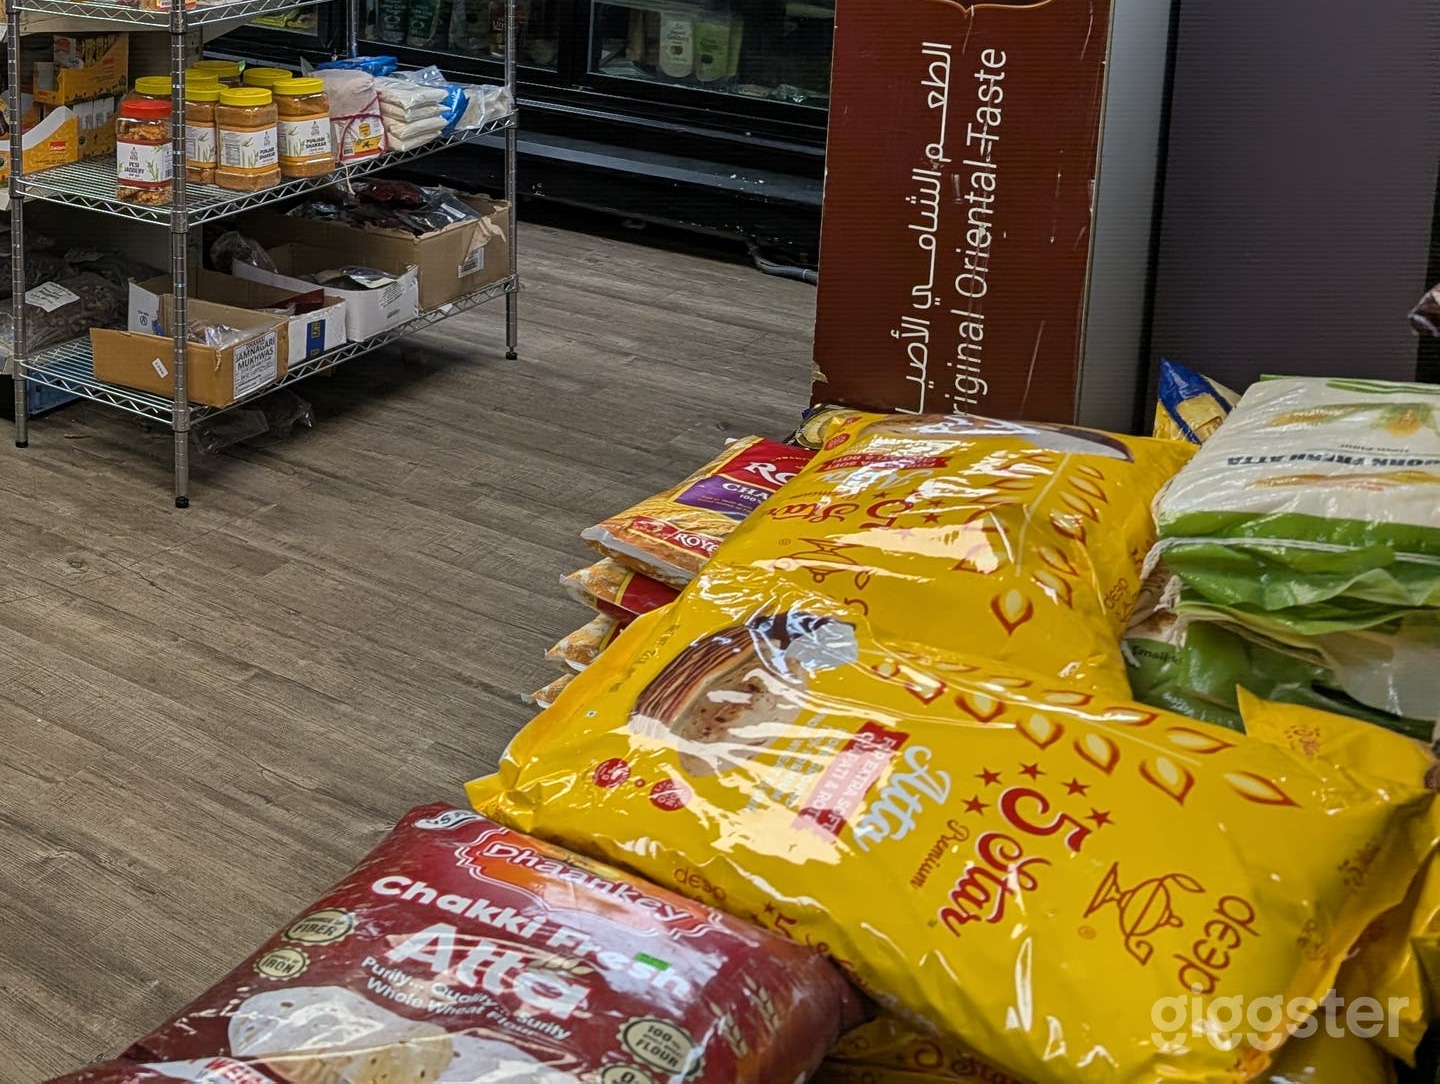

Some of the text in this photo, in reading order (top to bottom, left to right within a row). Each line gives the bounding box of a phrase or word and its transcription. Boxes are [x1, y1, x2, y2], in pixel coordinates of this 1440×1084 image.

[905, 169, 942, 310] الشامي
[944, 48, 1008, 415] riginal Oriental Taste
[237, 346, 274, 371] MUKHWAS
[722, 482, 769, 501] CHA
[859, 498, 916, 530] 5
[843, 762, 878, 799] EXTRA
[853, 745, 952, 853] Atta
[827, 795, 855, 835] SOFT
[998, 785, 1095, 854] 5
[482, 842, 694, 925] Dhaankey
[909, 818, 970, 891] Premium
[936, 830, 1053, 938] Star
[295, 918, 341, 939] FIBER
[371, 874, 692, 999] Chakki Fresh
[1173, 893, 1262, 995] deep
[261, 955, 296, 977] IRON
[387, 921, 592, 1019] Atta
[366, 976, 538, 1040] Whole Wheat Flour
[516, 1012, 571, 1042] Surity
[635, 1038, 680, 1068] FLOUR
